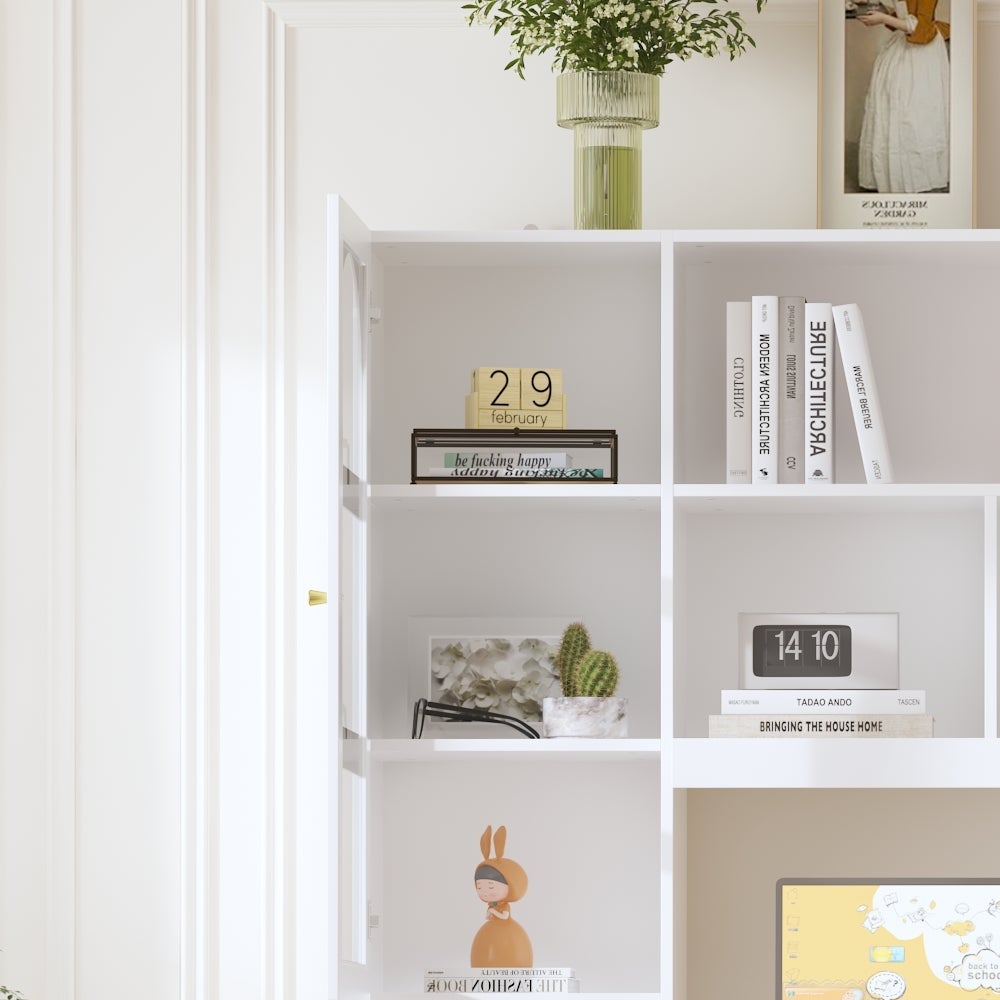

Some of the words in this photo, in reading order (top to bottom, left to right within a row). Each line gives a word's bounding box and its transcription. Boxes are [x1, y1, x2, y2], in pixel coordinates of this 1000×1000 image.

[491, 410, 548, 428] february
[454, 454, 468, 468] be
[471, 453, 514, 470] fucking
[517, 453, 552, 469] happy
[774, 630, 802, 661] 14
[811, 630, 840, 661] 10
[796, 698, 826, 707] TADAO
[828, 698, 852, 707] ANDO
[760, 721, 803, 732] BRINGING
[806, 721, 823, 732] THE
[826, 721, 855, 732] HOUSE
[857, 721, 883, 732] HOME
